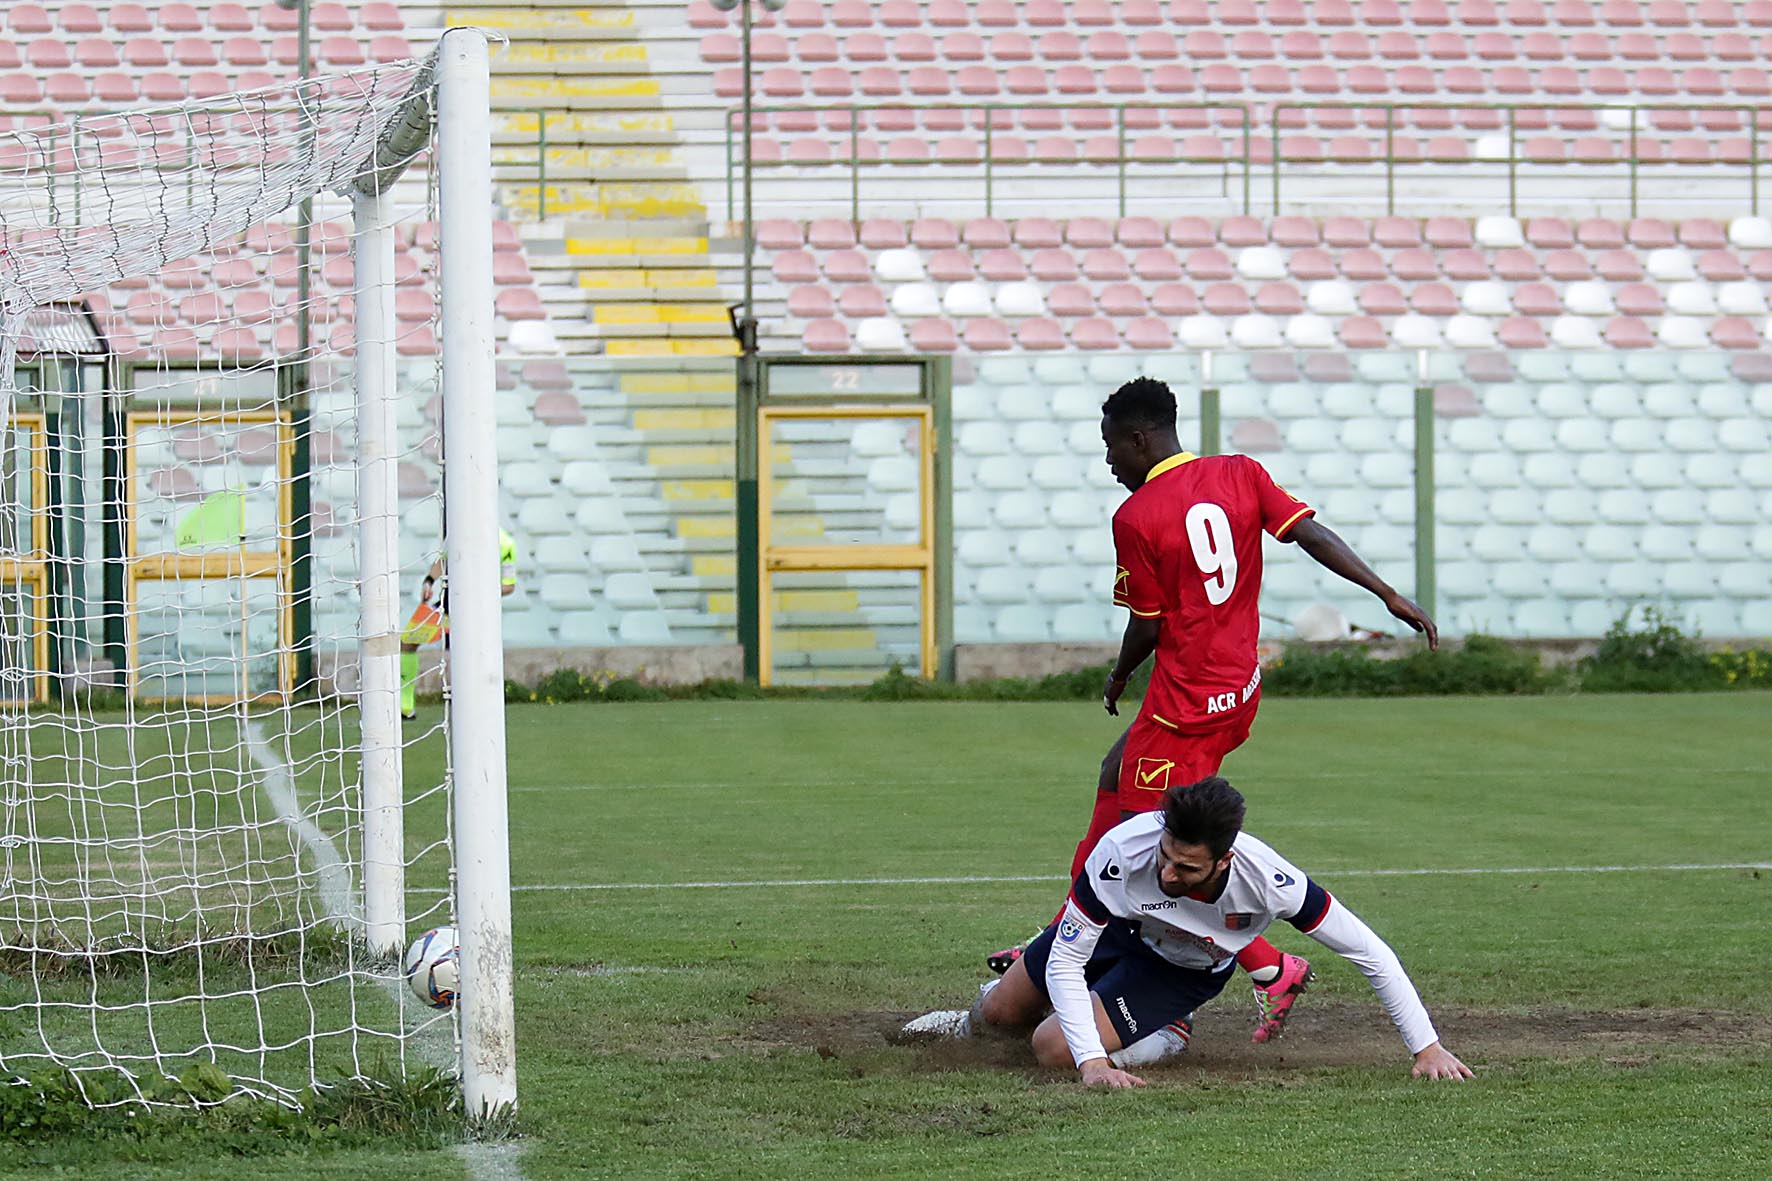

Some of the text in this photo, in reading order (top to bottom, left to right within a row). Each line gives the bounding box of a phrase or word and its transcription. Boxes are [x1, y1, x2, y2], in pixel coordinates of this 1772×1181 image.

[832, 372, 860, 389] 22
[1185, 502, 1238, 606] 9
[1207, 692, 1236, 714] ACR
[1141, 900, 1177, 912] macron
[1116, 996, 1138, 1034] macron
